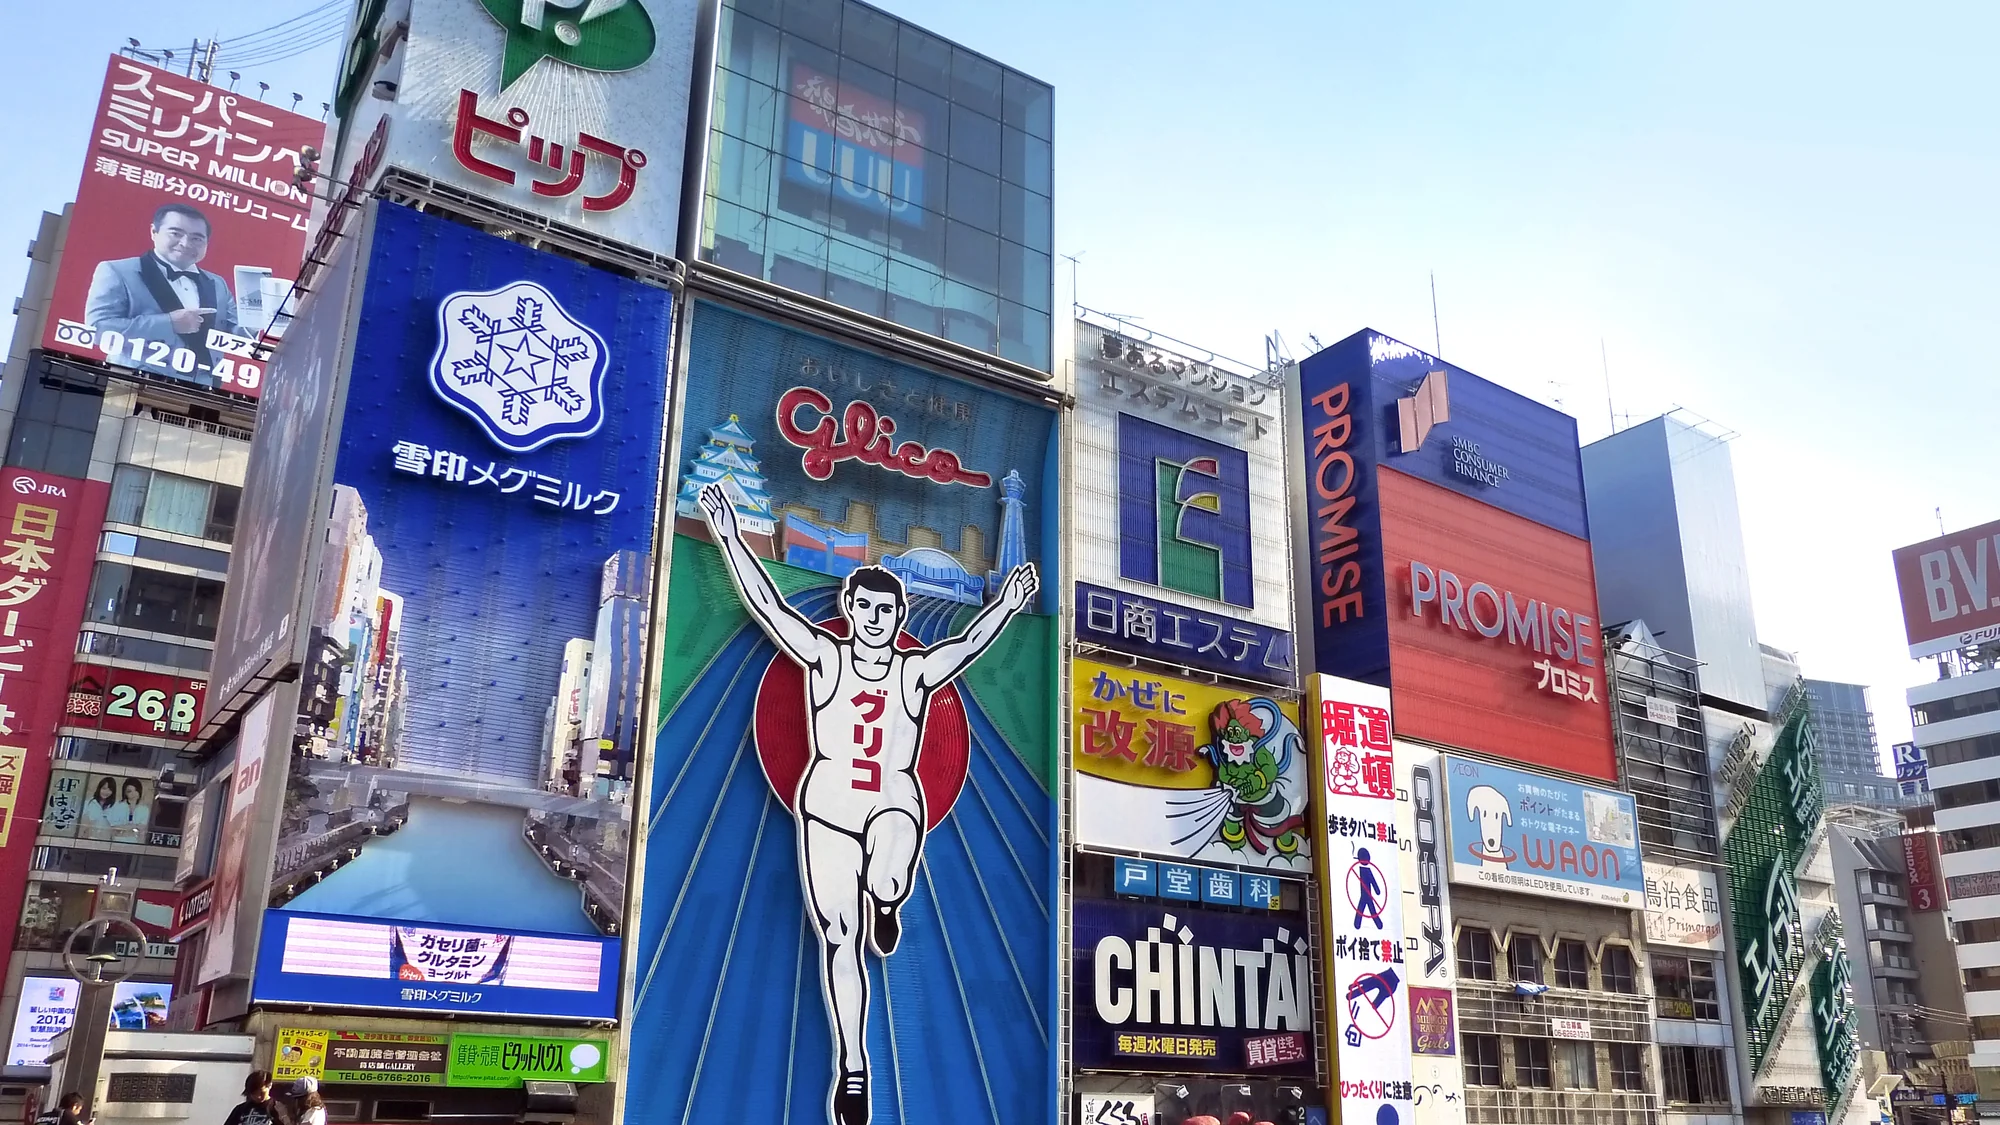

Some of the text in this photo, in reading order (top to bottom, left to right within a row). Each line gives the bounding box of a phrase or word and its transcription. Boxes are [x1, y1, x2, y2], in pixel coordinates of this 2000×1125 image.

[113, 62, 274, 128] スーパー
[101, 129, 309, 204] SUPER MILLION
[453, 88, 648, 212] ピップ
[801, 356, 971, 422] おいしさと健康
[1100, 368, 1268, 440] エステムコート
[776, 385, 993, 488] Glico
[1453, 435, 1480, 455] SMBC
[392, 440, 620, 515] 雪印メグミルク
[1453, 447, 1510, 481] CONSUMER
[1455, 461, 1500, 488] FINANCE
[38, 484, 67, 498] JRA
[1312, 382, 1364, 628] PROMISE
[1087, 591, 1291, 672] 日商エステム
[1409, 560, 1595, 668] PROMISE
[1090, 671, 1187, 715] かぜに
[1532, 660, 1600, 704] プロミス
[106, 685, 196, 724] 268
[850, 689, 888, 792] グリコ
[1080, 707, 1199, 772] 改源
[54, 778, 80, 792] 4F
[1328, 814, 1398, 844] 歩きタバコ禁止
[1412, 764, 1447, 978] COSPA
[1522, 834, 1620, 881] WAON
[1904, 837, 1919, 884] SHIDAX
[1123, 862, 1272, 904] 戸堂歯科
[1918, 889, 1931, 909] 3
[1336, 935, 1404, 964] ポイ捨て禁止
[1743, 850, 1800, 1024] エイブル
[418, 951, 486, 968] グルタミン
[428, 968, 472, 980] ヨーグルト
[1095, 913, 1310, 1031] CHINTAI
[401, 988, 482, 1003] 雪印メグミルク
[36, 1015, 67, 1025] 2014
[457, 1042, 563, 1072] 賃貸・売買 ピタットハウス
[1118, 1035, 1216, 1056] 毎週水曜日発売
[1247, 1038, 1278, 1065] 賃貸
[1277, 1036, 1294, 1049] 住宅
[1279, 1047, 1305, 1060] ニュース
[1417, 1035, 1450, 1053] Girls
[1340, 1080, 1412, 1100] ひったくりに注意
